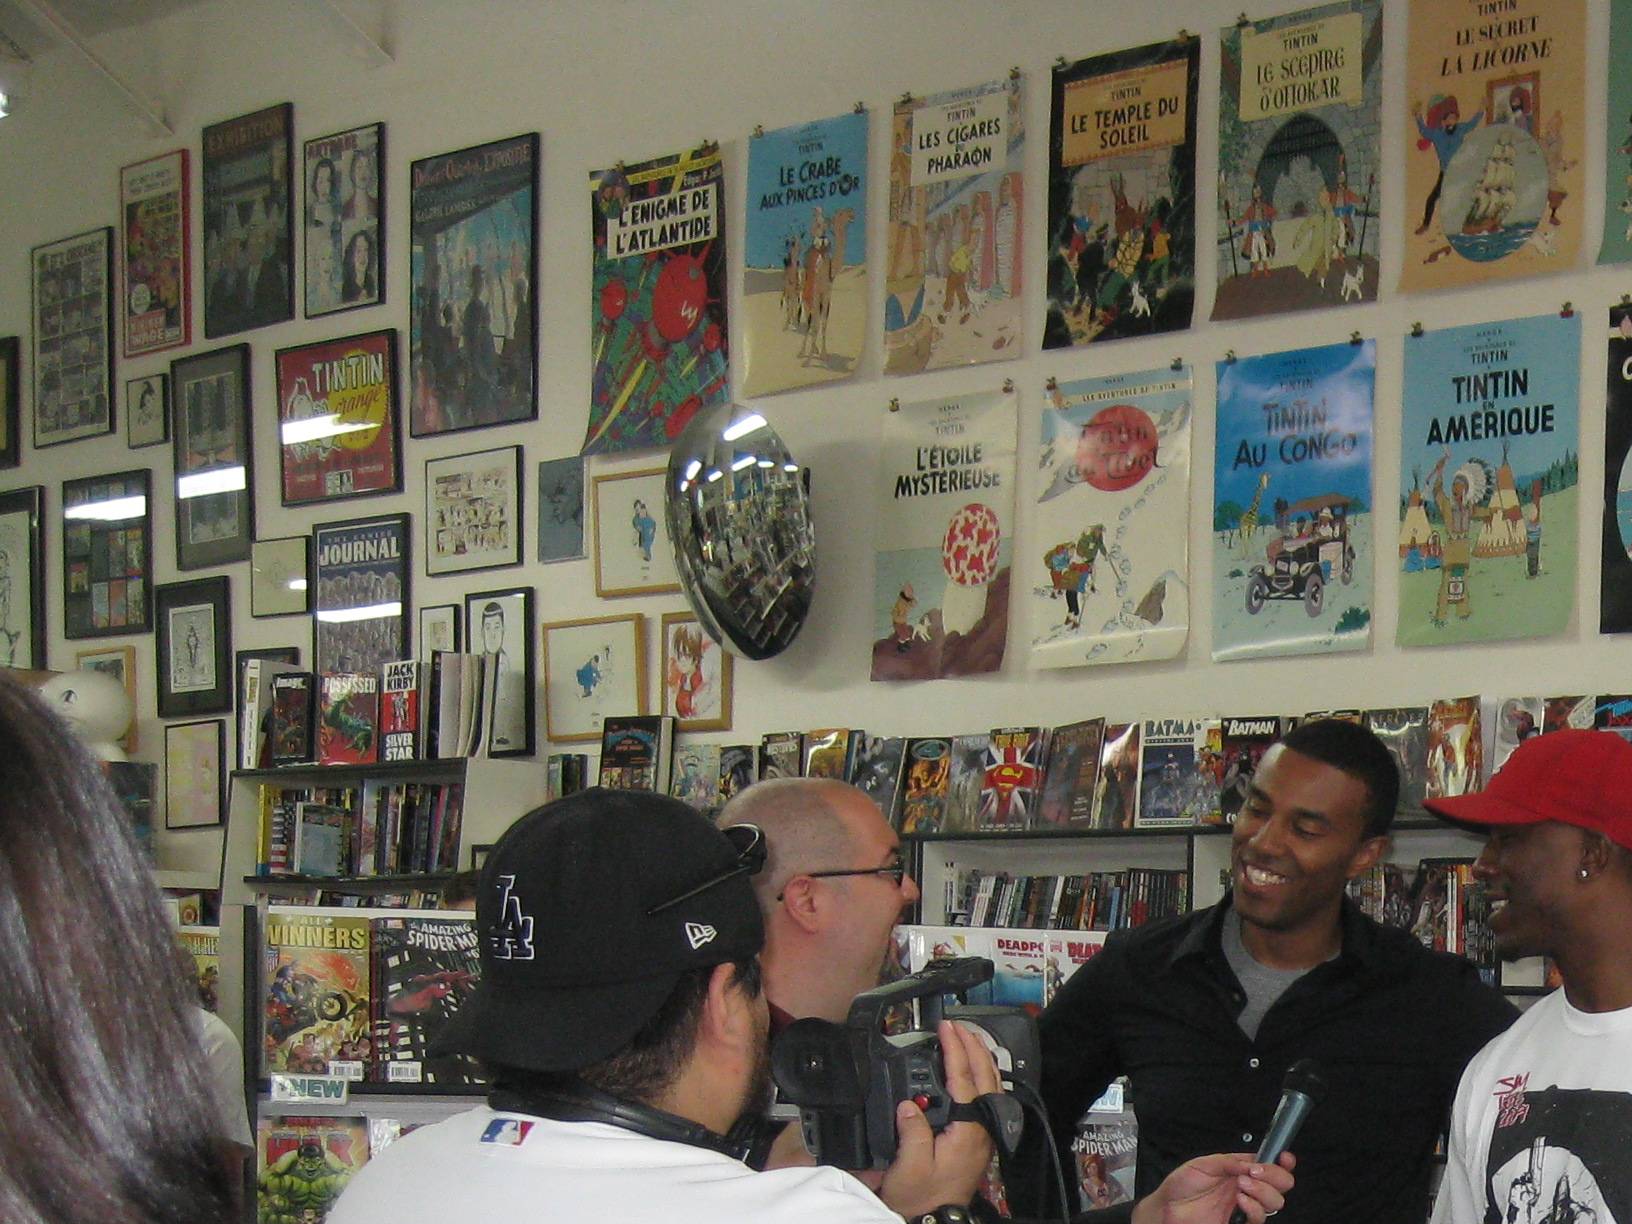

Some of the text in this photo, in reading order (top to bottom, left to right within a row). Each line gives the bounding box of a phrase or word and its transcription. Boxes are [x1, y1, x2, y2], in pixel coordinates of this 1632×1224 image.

[1477, 1, 1517, 16] TINTIN
[1456, 16, 1539, 45] LE SECRET
[1282, 34, 1318, 50] TINTIN
[1441, 38, 1553, 76] LA LICORNE
[1111, 87, 1141, 100] TINTIN
[947, 106, 976, 121] TINTIN
[1071, 96, 1179, 134] LE TEMPLE DU
[919, 118, 1001, 149] LES CIGARES
[1099, 128, 1150, 150] SOLEIL
[779, 156, 842, 186] LE CRABE
[927, 147, 992, 174] PHARAON
[618, 189, 710, 228] L'ENIGME DE
[760, 193, 783, 211] AUX
[786, 184, 826, 204] PINCES
[616, 216, 712, 254] L'ATLANTIDE
[1471, 350, 1508, 364] TINTIN
[312, 353, 384, 392] TINTIN
[1452, 368, 1529, 404] TINTIN
[1482, 401, 1495, 411] EN
[916, 442, 982, 472] L'ÉTOILE
[1278, 431, 1357, 466] CONGO
[894, 467, 1001, 500] MYSTÉRIEUSE
[319, 536, 400, 566] JOURNAL
[388, 663, 413, 678] JACK
[324, 677, 376, 694] POSSESSED
[387, 677, 414, 689] KIRBY
[1228, 721, 1276, 736] BATMAN
[385, 733, 413, 748] SILVER
[386, 747, 414, 761] STAR
[421, 922, 471, 936] AMAZING
[290, 1078, 344, 1099] NEW
[1083, 1130, 1124, 1141] AMAZING
